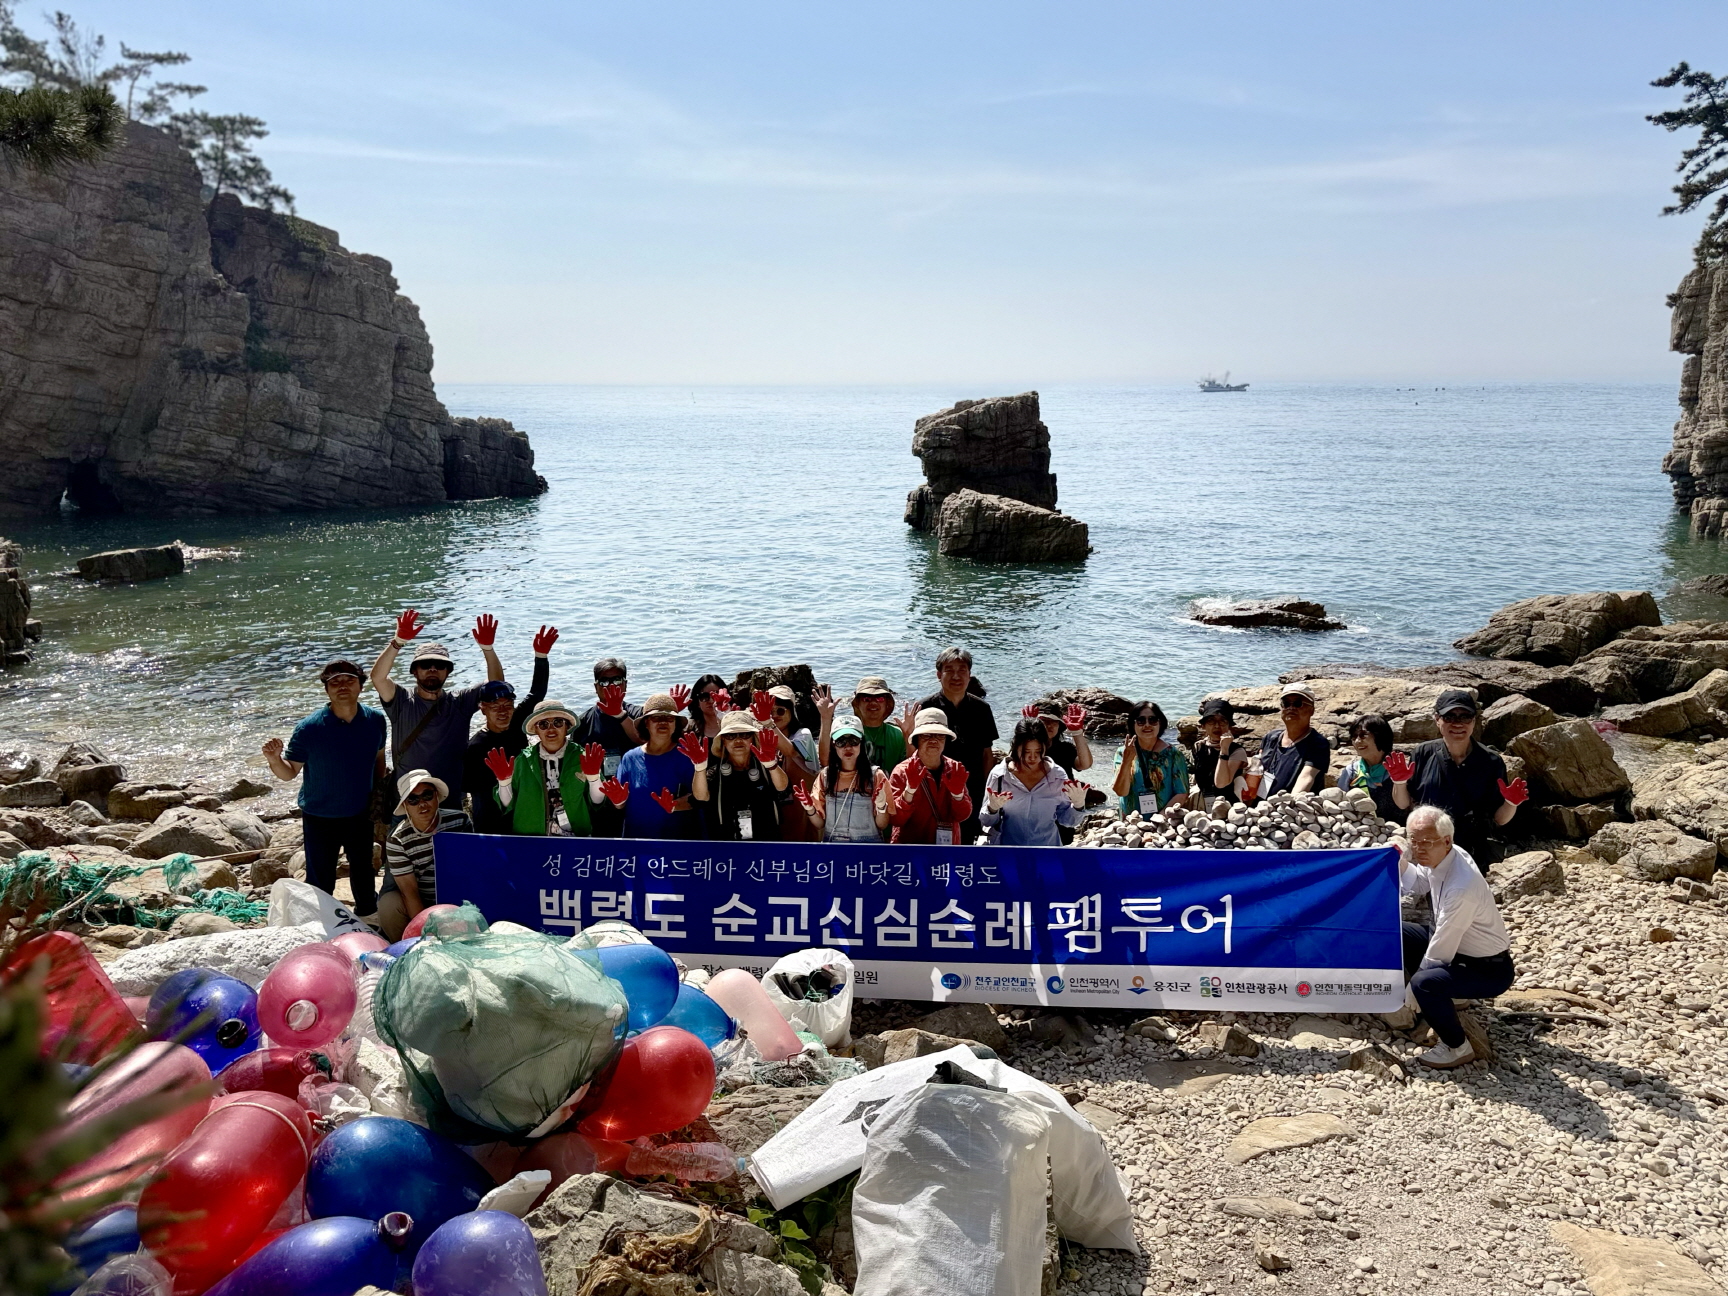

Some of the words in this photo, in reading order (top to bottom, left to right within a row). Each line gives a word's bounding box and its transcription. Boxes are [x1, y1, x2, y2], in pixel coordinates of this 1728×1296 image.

[542, 854, 561, 876] 성
[572, 854, 636, 879] 김대건
[647, 857, 737, 881] 안드레아
[745, 859, 834, 884] 신부님의
[845, 862, 920, 887] 바닷길,
[931, 863, 1001, 888] 백령도
[711, 893, 1032, 951] 순교신심순례
[1047, 893, 1233, 954] 팸투어
[975, 976, 1037, 987] 천주교인천교구
[1069, 977, 1120, 989] 인천광역시
[1153, 981, 1192, 993] 옹진군
[1314, 983, 1392, 992] 인천가톨릭대학교
[1224, 982, 1288, 994] 인천관광공사
